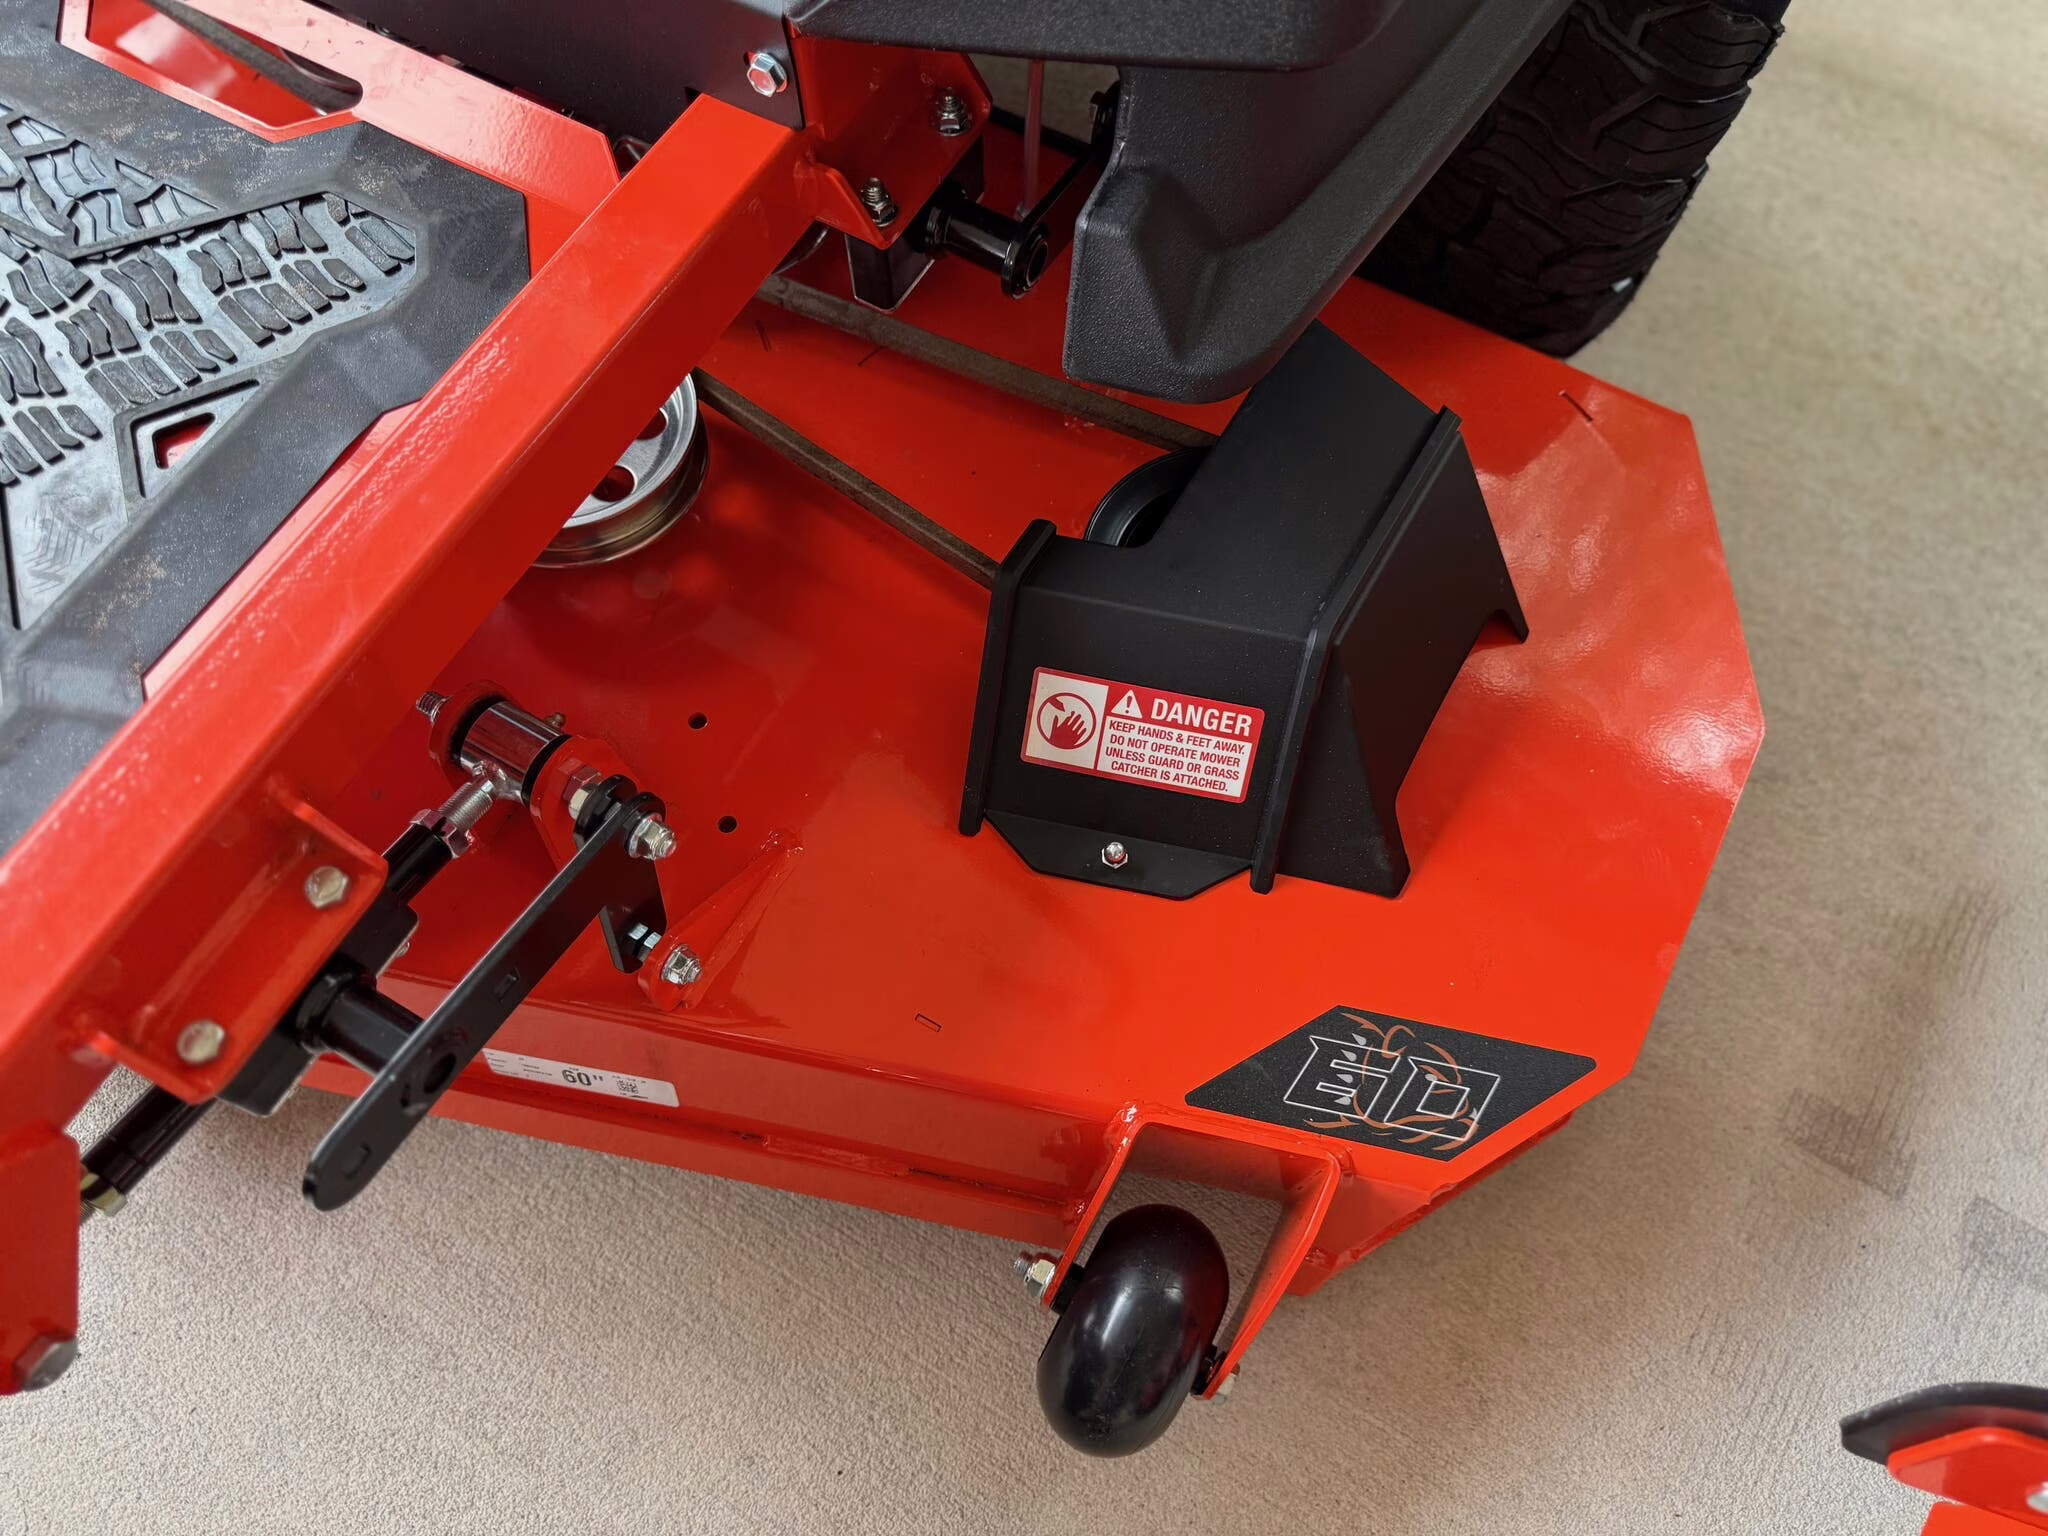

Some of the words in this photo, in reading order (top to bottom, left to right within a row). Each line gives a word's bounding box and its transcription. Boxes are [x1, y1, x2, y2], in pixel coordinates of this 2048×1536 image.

[1151, 697, 1252, 737] DANGER
[1109, 719, 1136, 733] KEEP
[1137, 725, 1174, 741] HANDS
[1175, 733, 1184, 743] &
[1186, 735, 1212, 748] FEET
[1213, 740, 1245, 755] AWAY.
[1109, 734, 1125, 745] DO
[1127, 737, 1148, 750] NOT
[1150, 742, 1198, 760] OPERATE
[1199, 751, 1240, 767] MOWER
[1105, 746, 1146, 763] UNLESS
[1148, 754, 1184, 770] GUARD
[1186, 762, 1202, 774] OR
[1204, 765, 1240, 781] GRASS
[1111, 760, 1158, 778] CATCHER
[1160, 770, 1171, 781] IS
[1172, 772, 1228, 792] ATTACHED.
[561, 1069, 604, 1086] 60"
